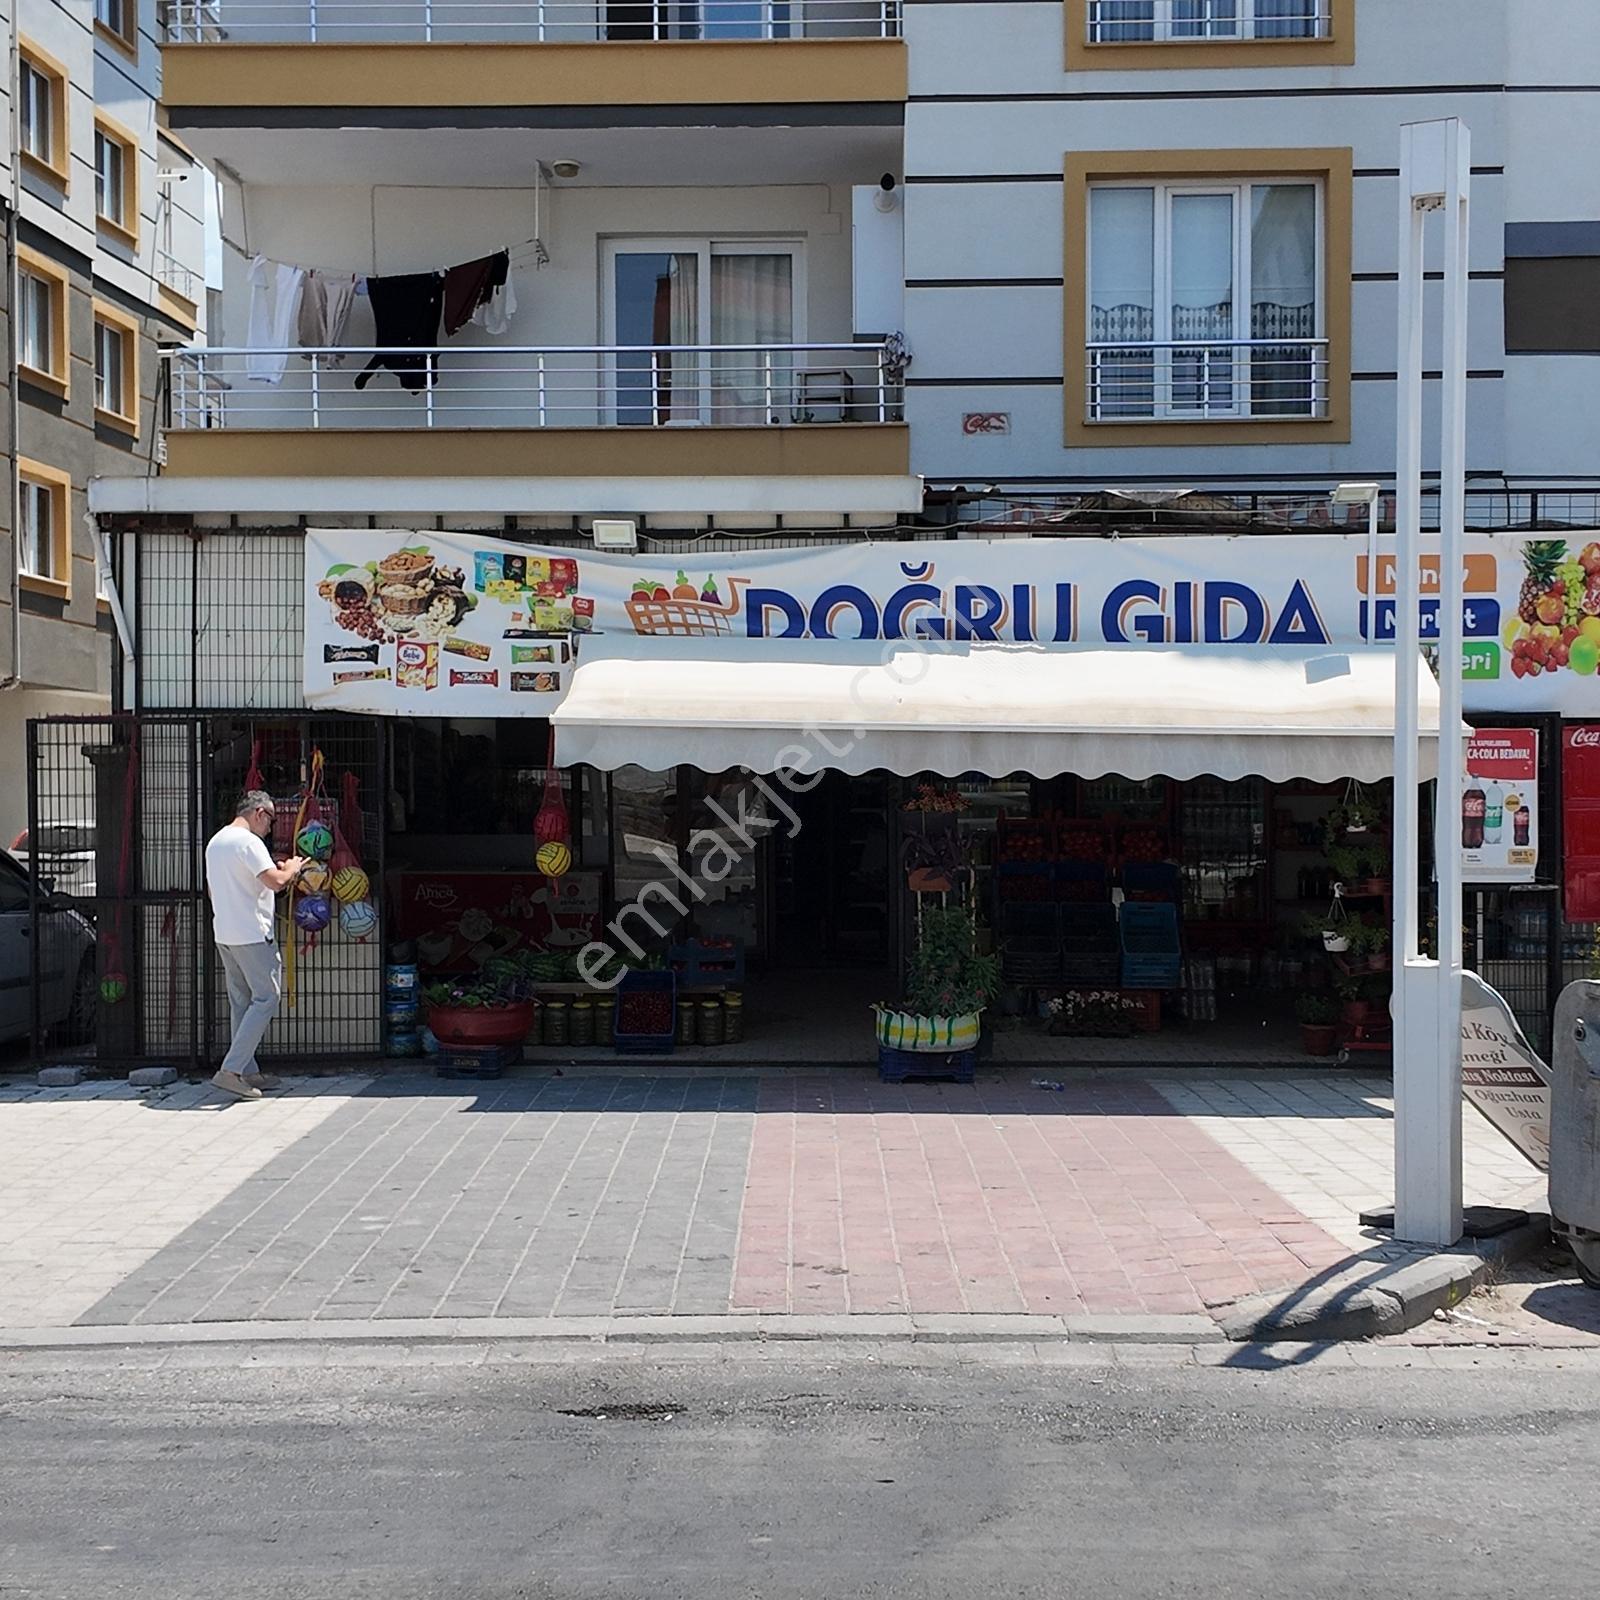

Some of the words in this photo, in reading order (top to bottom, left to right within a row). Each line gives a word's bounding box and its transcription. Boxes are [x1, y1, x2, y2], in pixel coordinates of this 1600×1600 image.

[745, 561, 1078, 642] DOĞRU
[1101, 578, 1332, 644] GIDA
[1462, 1049, 1508, 1064] meği
[1474, 1089, 1544, 1104] Oğuzhan
[1504, 1106, 1543, 1120] Usta
